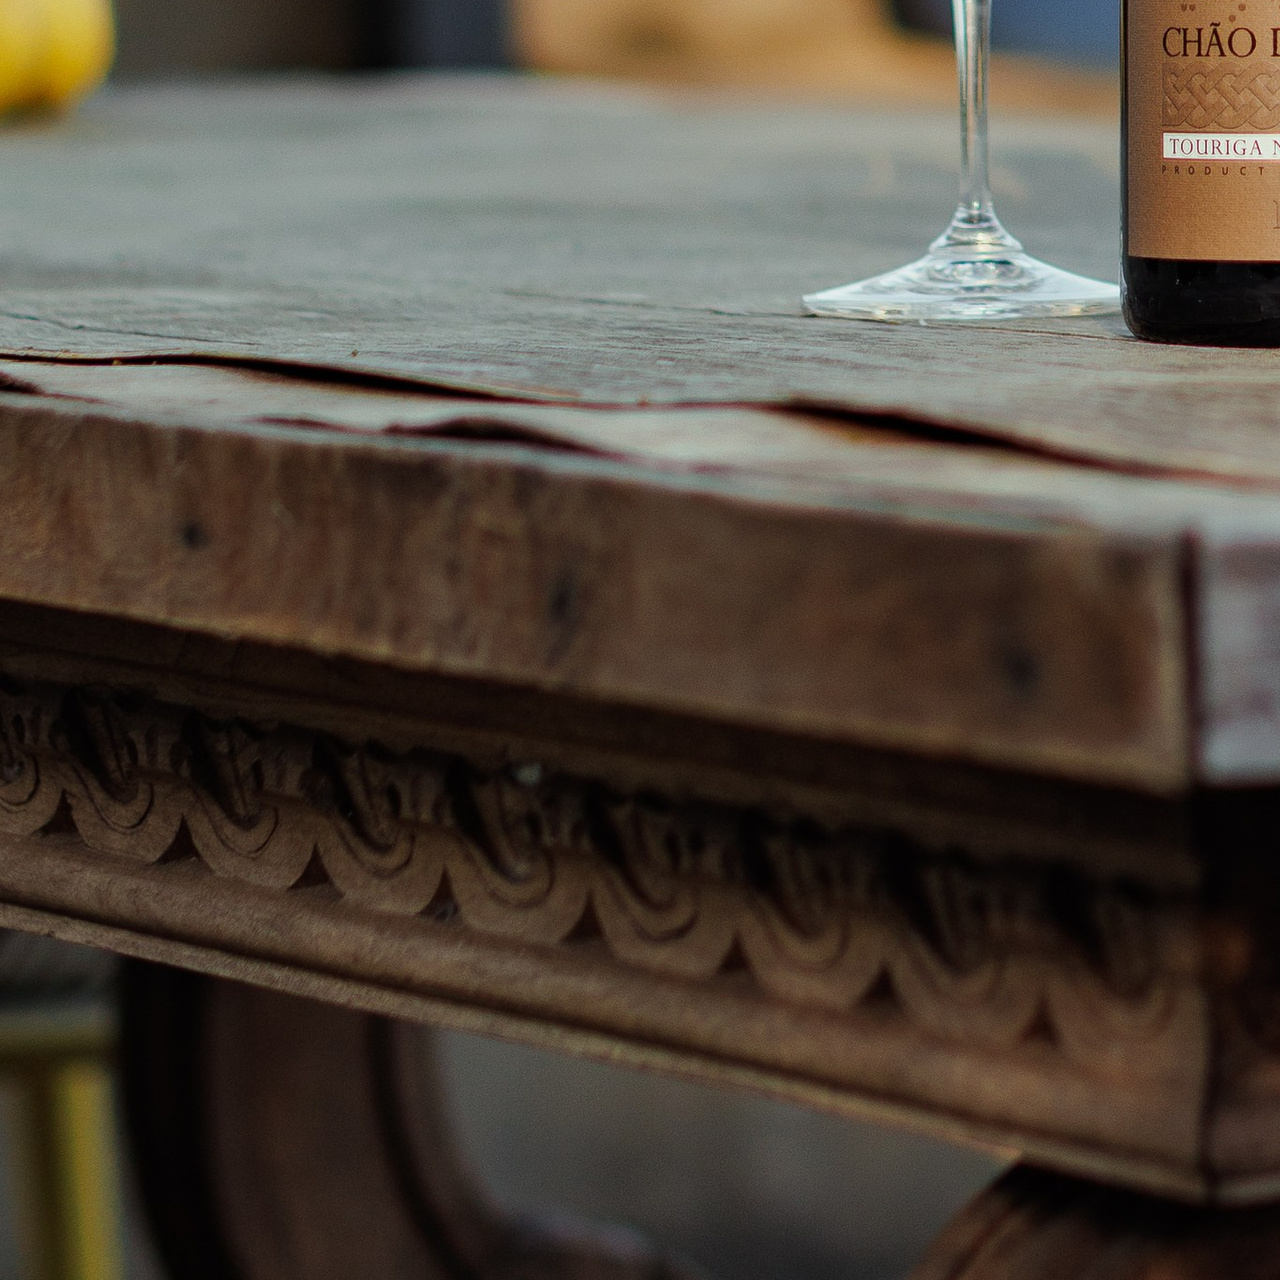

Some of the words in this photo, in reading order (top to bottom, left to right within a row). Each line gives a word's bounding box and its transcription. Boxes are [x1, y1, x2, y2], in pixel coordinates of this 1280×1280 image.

[1162, 22, 1257, 58] CHÃO
[1169, 137, 1263, 156] TOURIGA
[1161, 165, 1266, 176] PRODUCT
